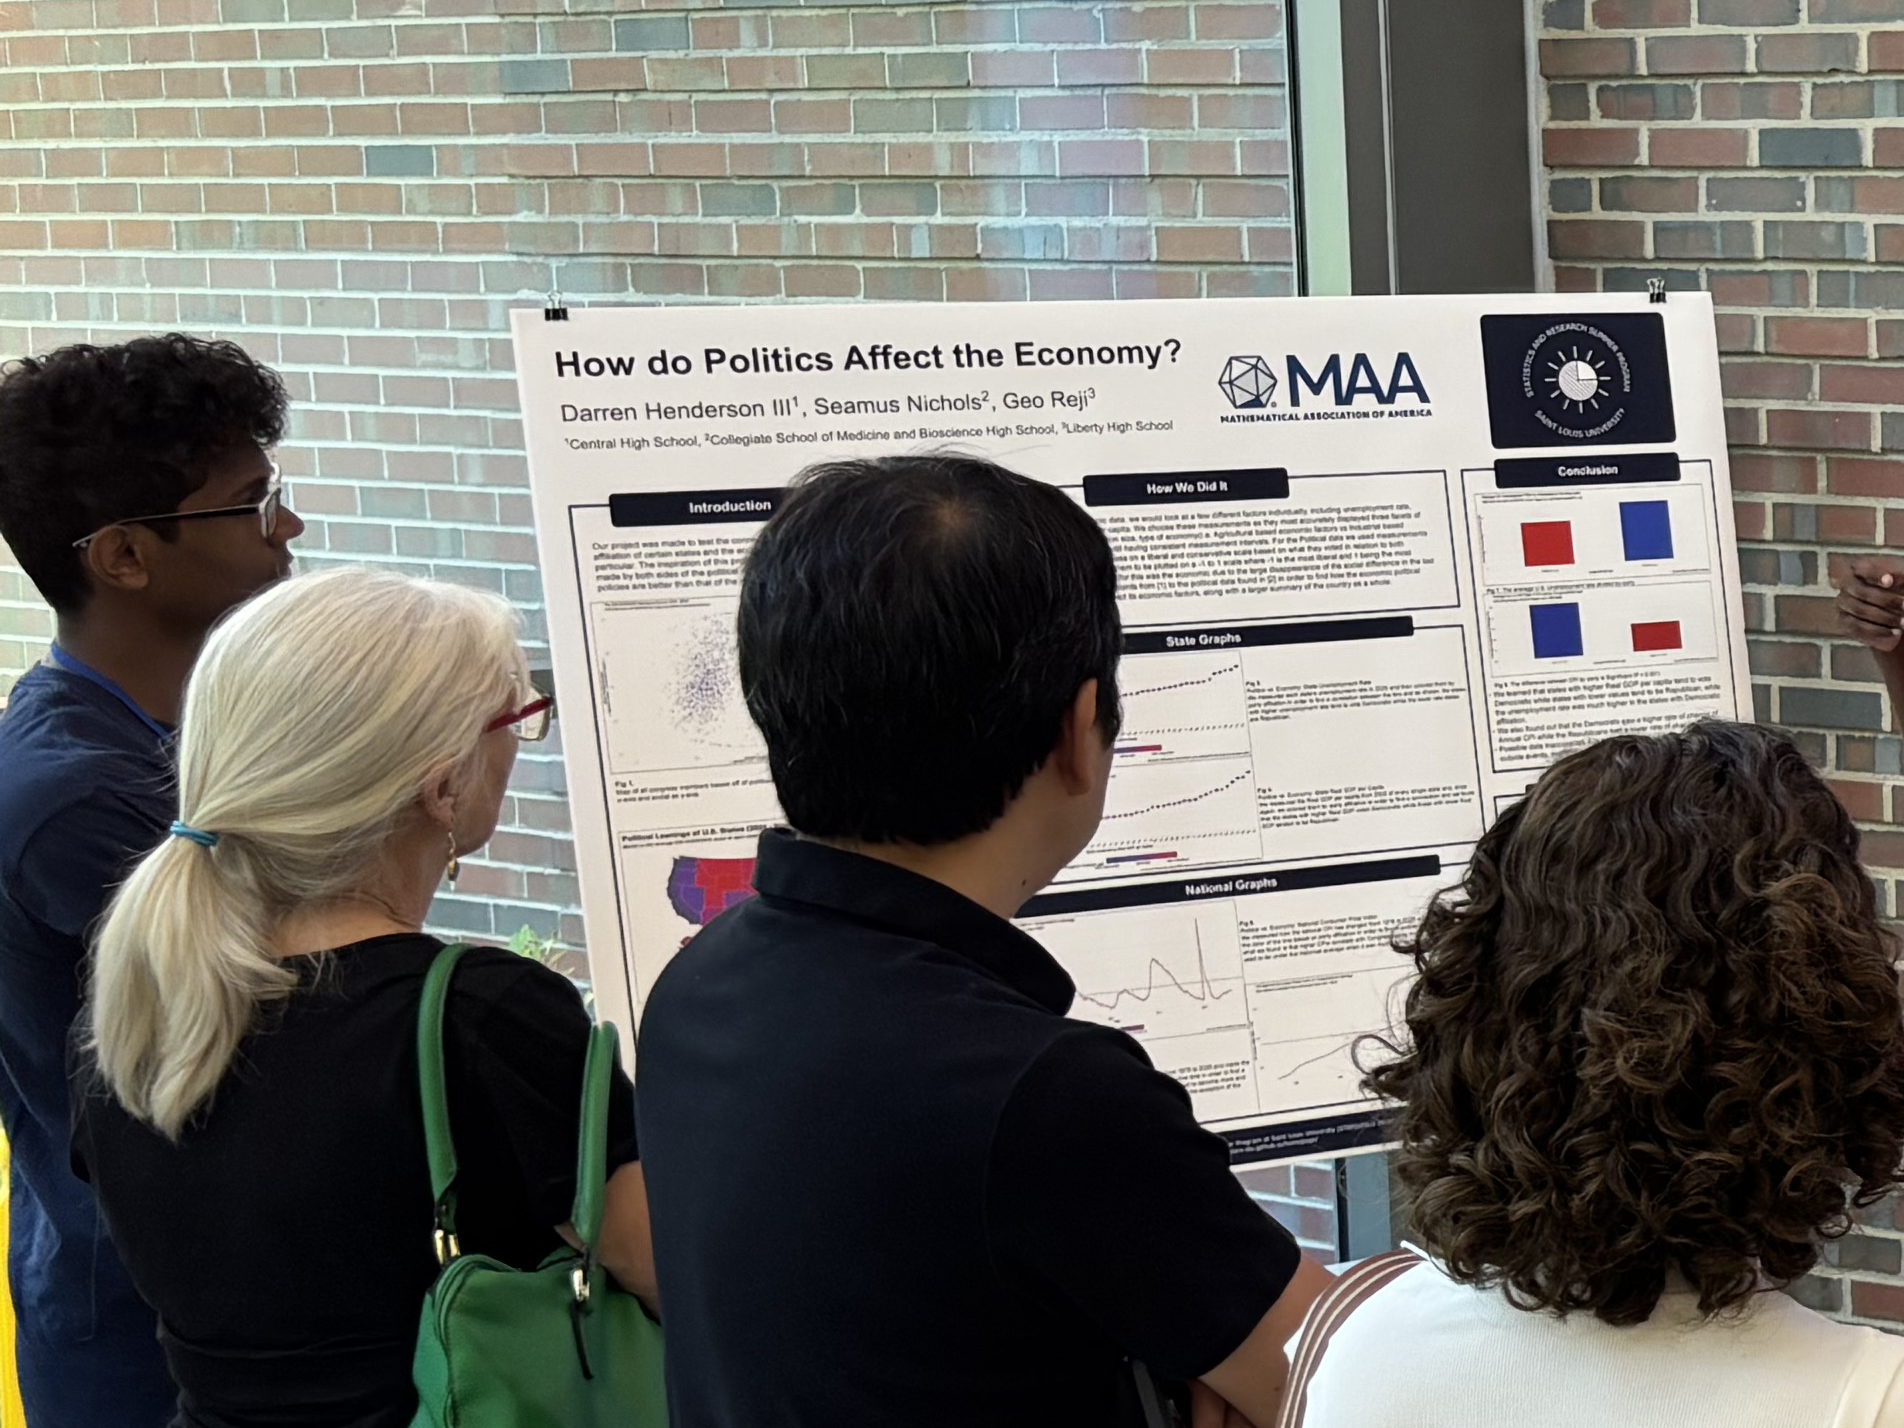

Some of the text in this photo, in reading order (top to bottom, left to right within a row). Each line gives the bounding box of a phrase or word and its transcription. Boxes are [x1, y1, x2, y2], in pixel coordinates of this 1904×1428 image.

[555, 338, 1182, 377] How do Politics Affect the Economy?
[1286, 352, 1432, 408] MAA
[1523, 349, 1535, 398] STATISTICS
[561, 403, 637, 422] Darren
[645, 401, 765, 421] Henderson
[813, 397, 900, 415] Seamus
[1002, 392, 1044, 410] Geo
[1220, 408, 1432, 424] MATHEMATICAL ASSOCIATION OF AMERICA
[620, 436, 650, 450] High
[654, 435, 702, 449] School,
[776, 431, 818, 443] School
[821, 431, 834, 443] of
[837, 428, 890, 442] Medicine
[894, 428, 916, 440] and
[919, 426, 983, 439] Bioscience
[986, 425, 1013, 437] High
[1016, 423, 1059, 436] School,
[1107, 420, 1133, 434] High
[1136, 419, 1174, 432] School
[1534, 408, 1626, 438] SAINT LOUIS UNIVERSITY
[1557, 464, 1619, 477] Conclusion
[1147, 480, 1229, 495] How We Did It
[689, 500, 772, 514] Introduction
[1166, 632, 1242, 648] State Graphs
[1185, 876, 1279, 898] National Graphs
